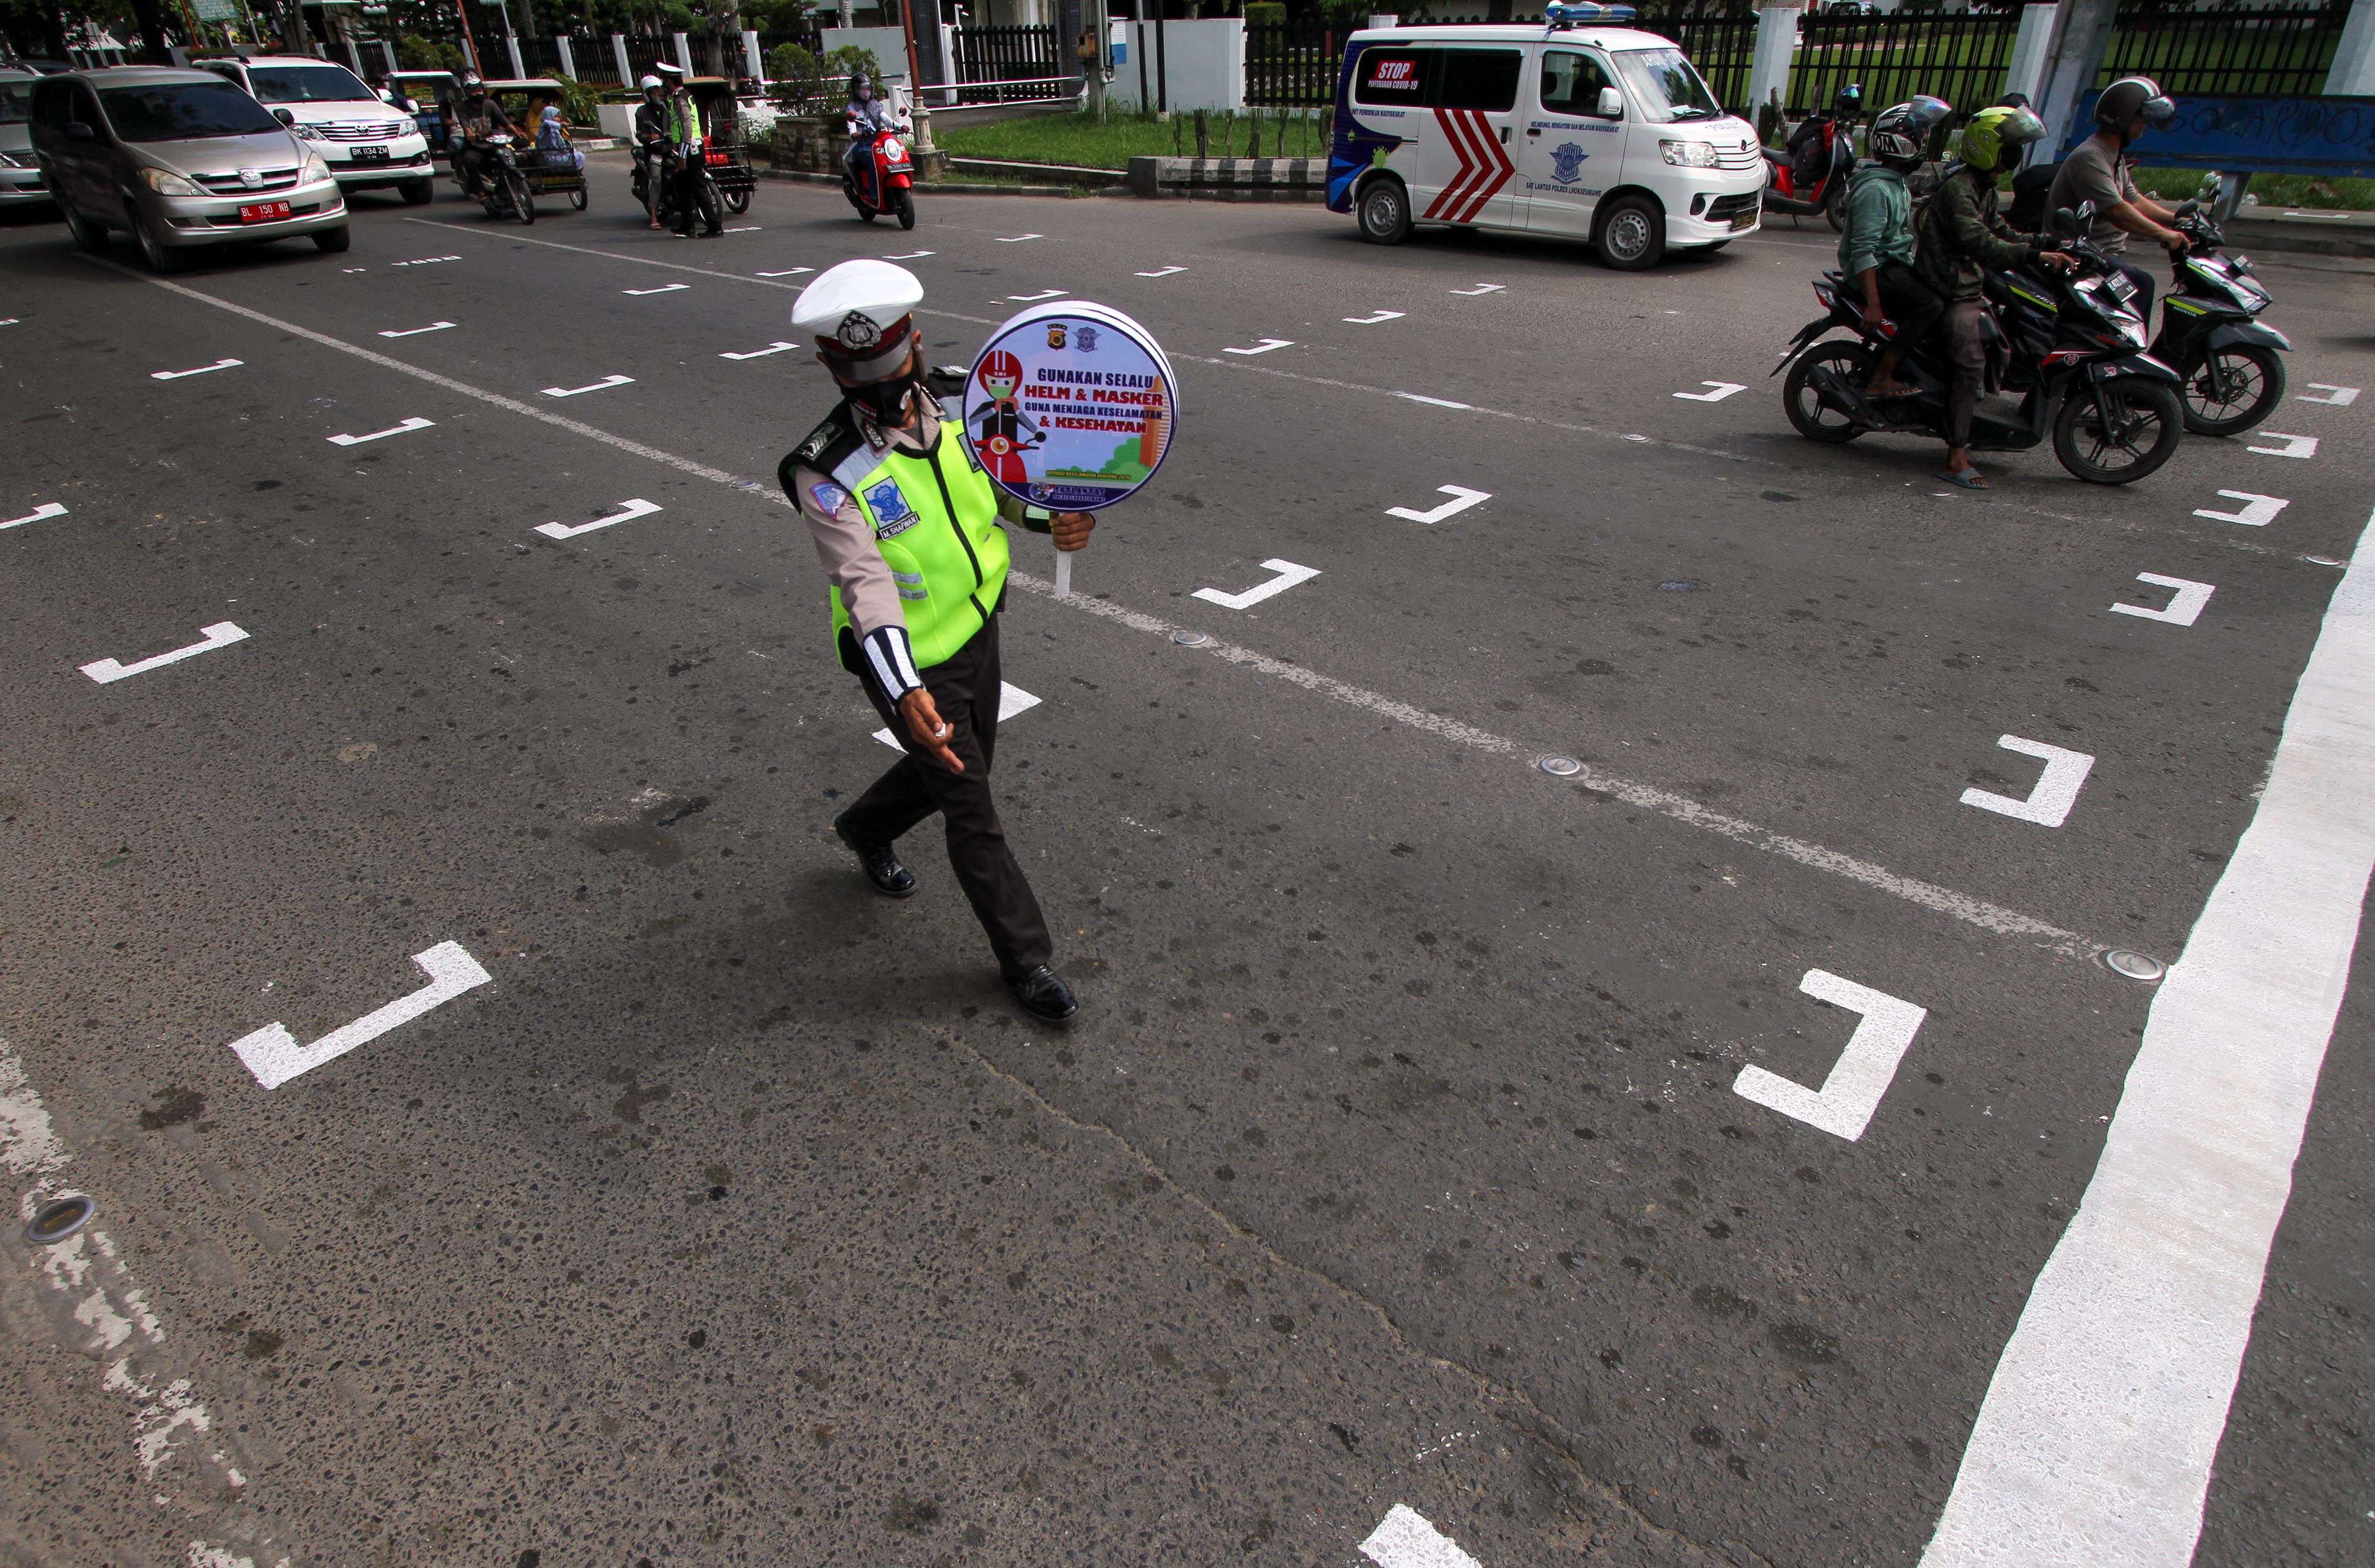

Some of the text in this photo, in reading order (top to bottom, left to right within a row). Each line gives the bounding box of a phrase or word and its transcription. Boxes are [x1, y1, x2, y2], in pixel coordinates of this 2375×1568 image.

[1378, 62, 1411, 79] STOP
[1368, 80, 1418, 91] PENYEBARAN COVID-19
[1595, 125, 1620, 133] MASYARAKAT
[1535, 183, 1551, 192] LANTAS
[1551, 185, 1569, 193] POLRES
[1569, 187, 1602, 197] LHOKSEUMAWE
[241, 202, 289, 217] BL 150 NB
[2173, 306, 2196, 317] HONDA
[1038, 368, 1154, 388] GUNAKAN SELALU
[1024, 385, 1164, 406] HELM & MASKER
[1024, 402, 1163, 420] GUNA MENJAGA KESELAMATAN
[1039, 416, 1147, 433] & KESEHATAN
[883, 516, 917, 538] M.SHAFWAN
